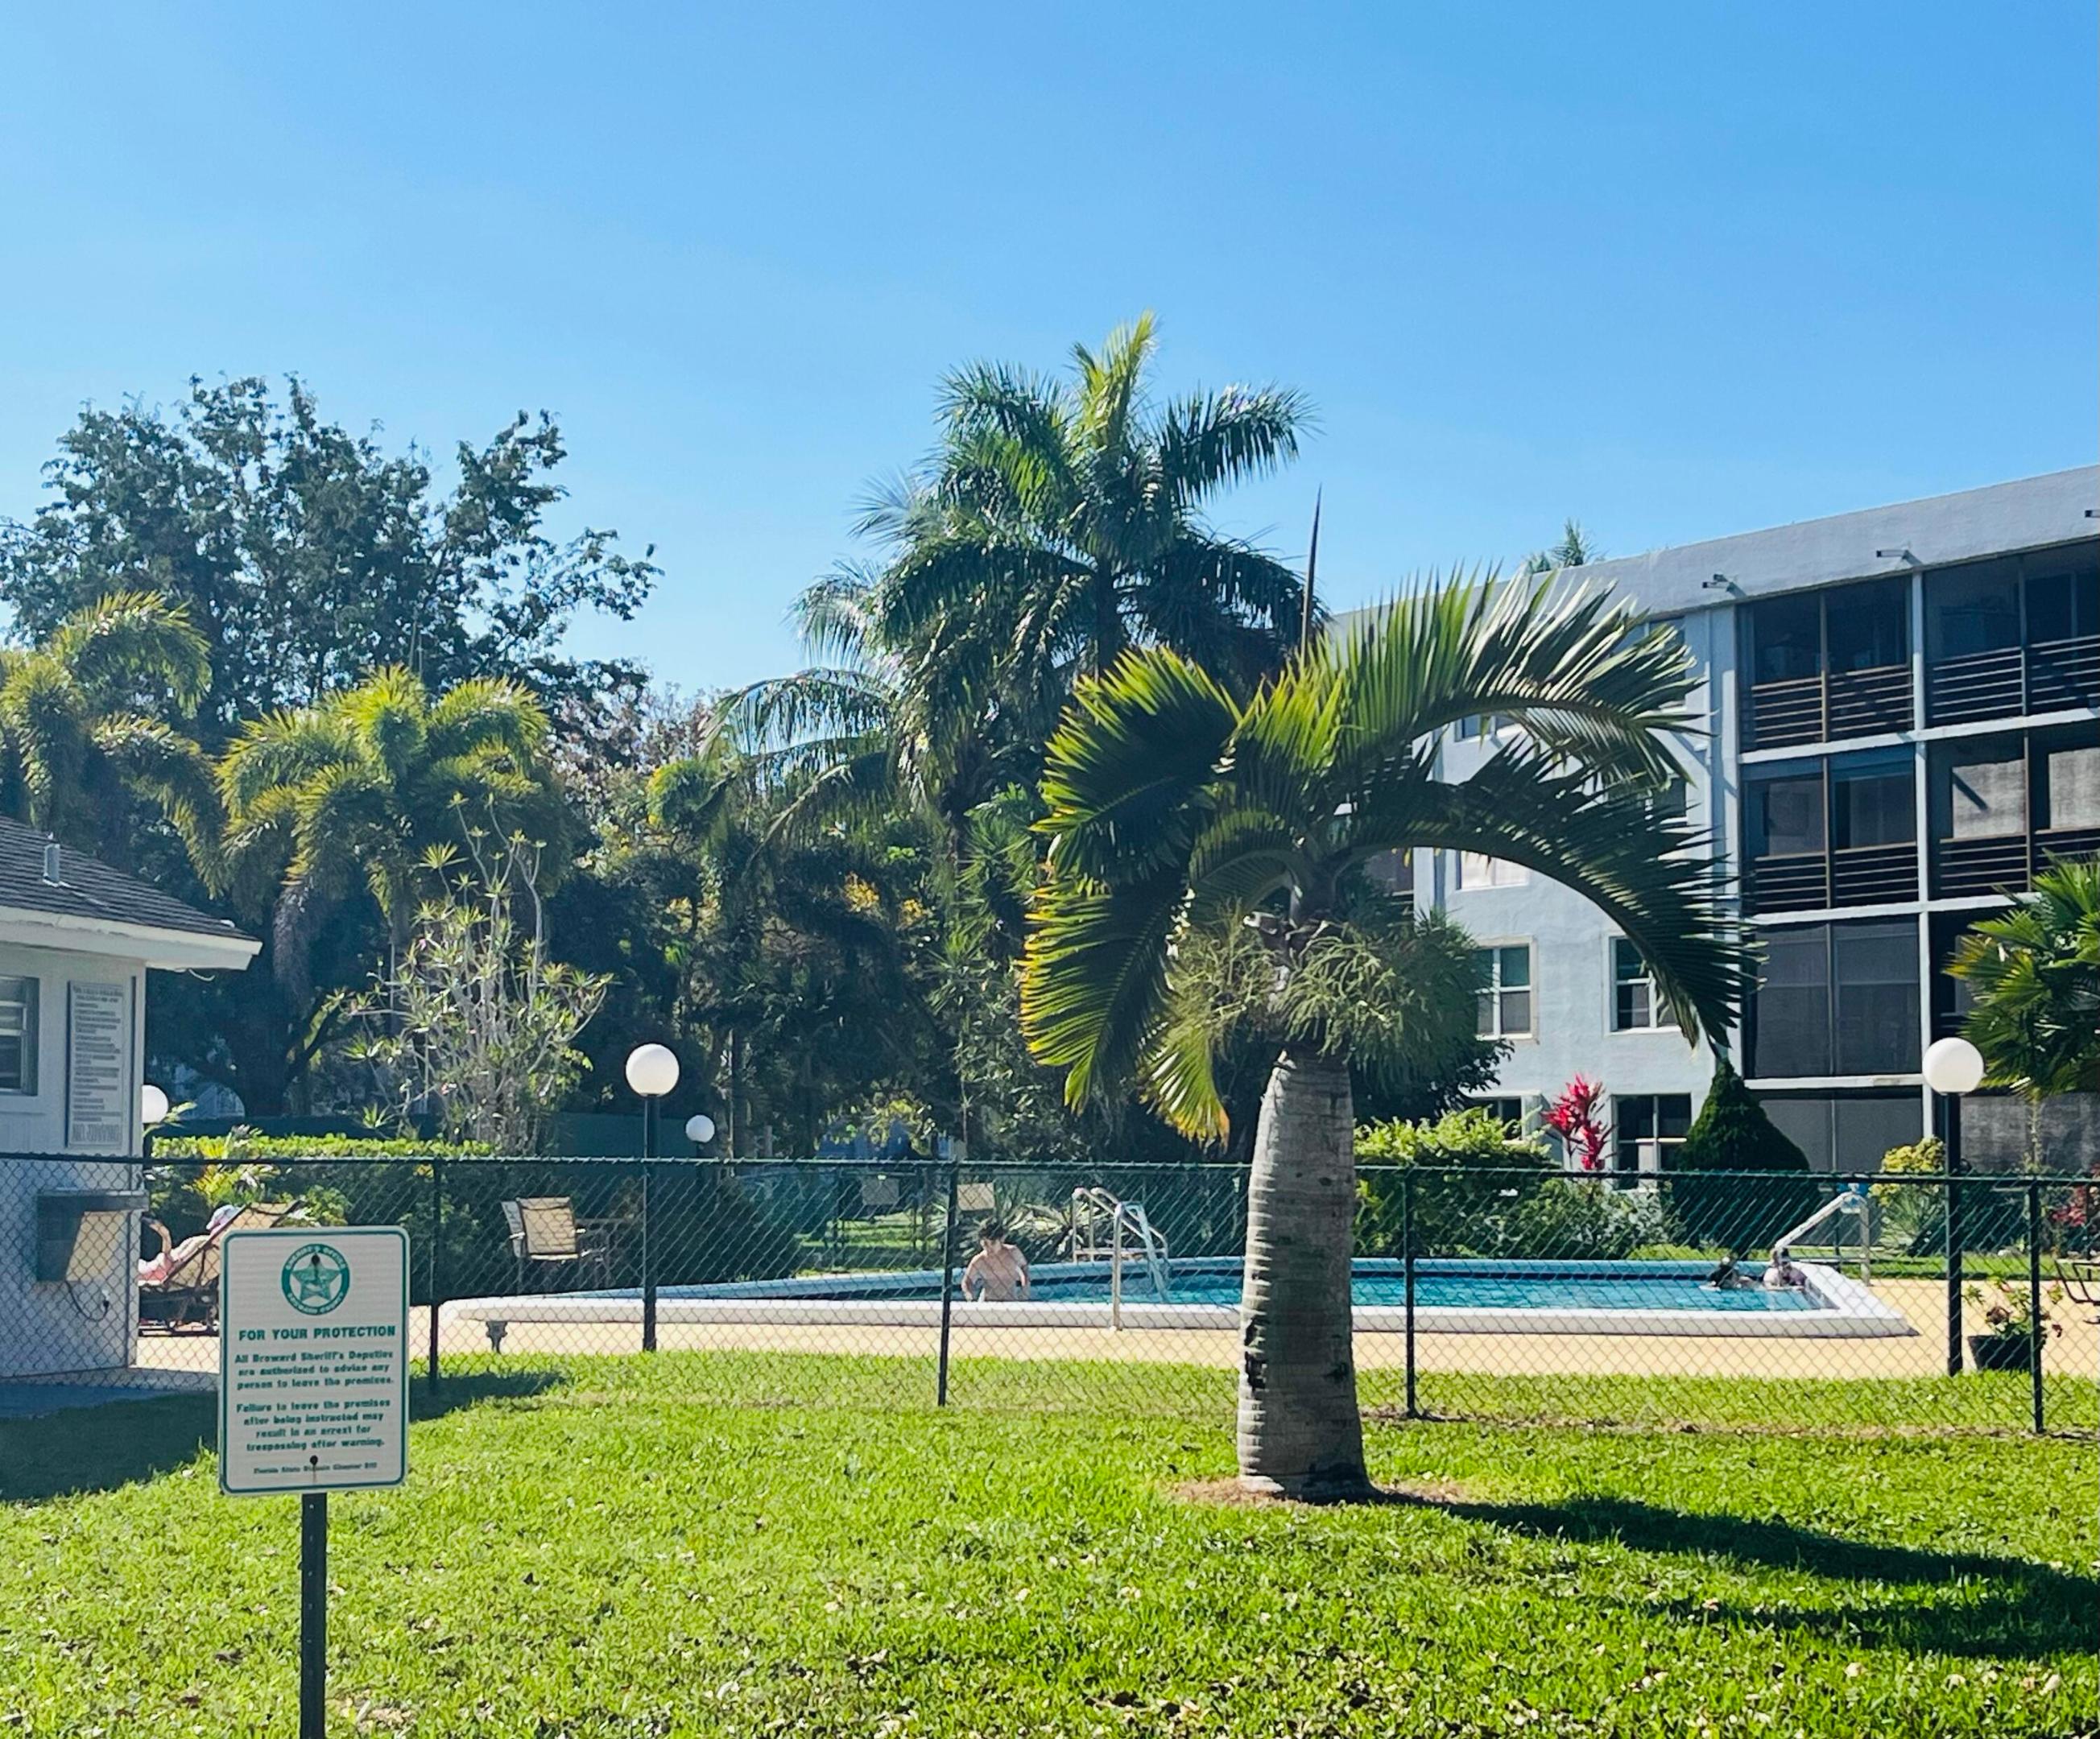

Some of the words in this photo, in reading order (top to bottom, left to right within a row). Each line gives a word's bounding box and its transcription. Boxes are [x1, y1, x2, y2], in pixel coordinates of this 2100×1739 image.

[239, 1330, 265, 1340] FOR
[272, 1328, 308, 1340] YOUR
[313, 1326, 395, 1339] PROTECTION
[234, 1354, 249, 1363] All
[253, 1353, 296, 1362] Broward
[301, 1351, 345, 1361] Sheriff's
[349, 1350, 393, 1360] Deputies
[260, 1365, 315, 1375] authorized
[320, 1365, 329, 1373] to
[334, 1365, 367, 1373] advise
[371, 1364, 390, 1373] any
[237, 1382, 273, 1390] person
[277, 1380, 287, 1388] to
[291, 1379, 320, 1387] leave
[325, 1378, 341, 1386] the
[345, 1376, 394, 1386] premises.
[237, 1403, 271, 1413] Failure
[277, 1403, 287, 1411] to
[324, 1401, 339, 1409] the
[344, 1399, 391, 1409] premises
[244, 1417, 269, 1426] after
[274, 1415, 302, 1424] being
[306, 1413, 358, 1423] instructed
[362, 1413, 383, 1421] may
[256, 1429, 286, 1438] result
[291, 1427, 300, 1436] in
[320, 1426, 352, 1435] arrest
[356, 1425, 371, 1434] for
[246, 1441, 307, 1452] trespassing
[311, 1440, 337, 1449] after
[341, 1438, 385, 1448] warning.
